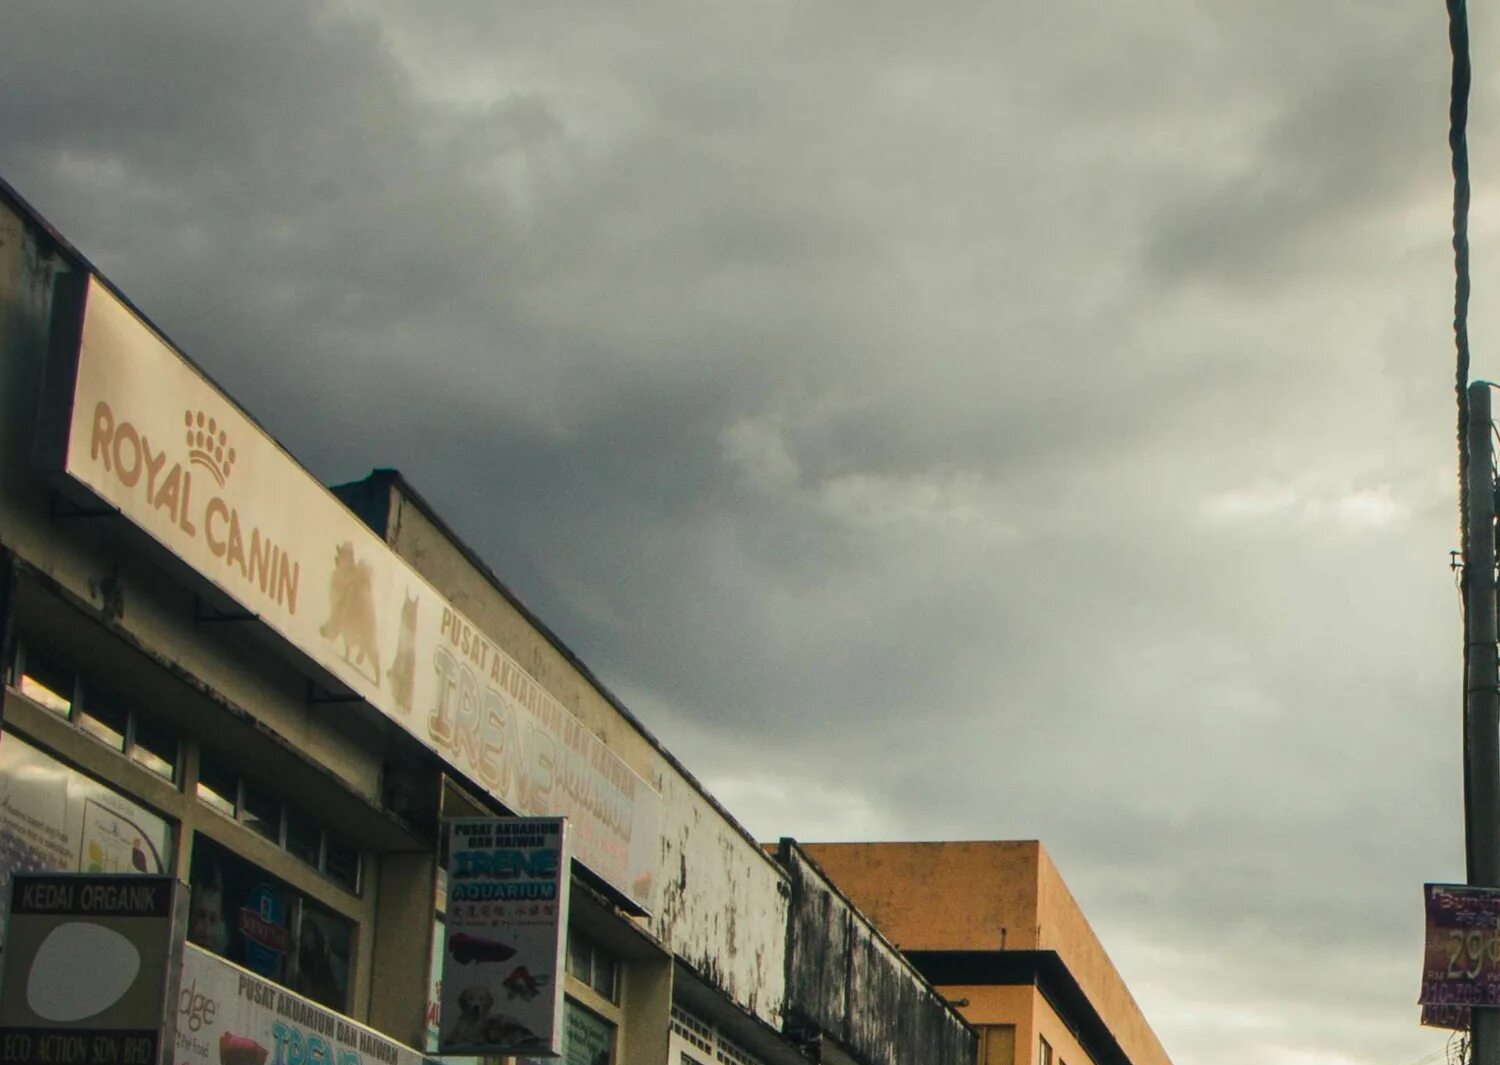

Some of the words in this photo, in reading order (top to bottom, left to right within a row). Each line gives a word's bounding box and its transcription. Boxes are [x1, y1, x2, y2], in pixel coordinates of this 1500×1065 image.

[91, 401, 196, 538] ROYAL
[205, 497, 300, 615] CANIN
[441, 606, 490, 671] PUSAT
[428, 644, 557, 818] IRENE
[454, 824, 491, 836] PUSAT
[495, 823, 560, 835] AKUARIUM
[452, 849, 559, 879] IRENE
[23, 884, 74, 909] KEDAI
[80, 884, 156, 911] ORGANIK
[452, 882, 556, 901] AQUARIUM
[179, 977, 216, 1032] dge
[238, 974, 275, 1010] PUSAT
[277, 991, 336, 1037] AKUARIUM
[337, 1020, 358, 1048] DAN
[4, 1034, 32, 1062] ECO
[38, 1035, 83, 1063] ACTION
[91, 1036, 119, 1063] SDN
[123, 1037, 151, 1064] BHD
